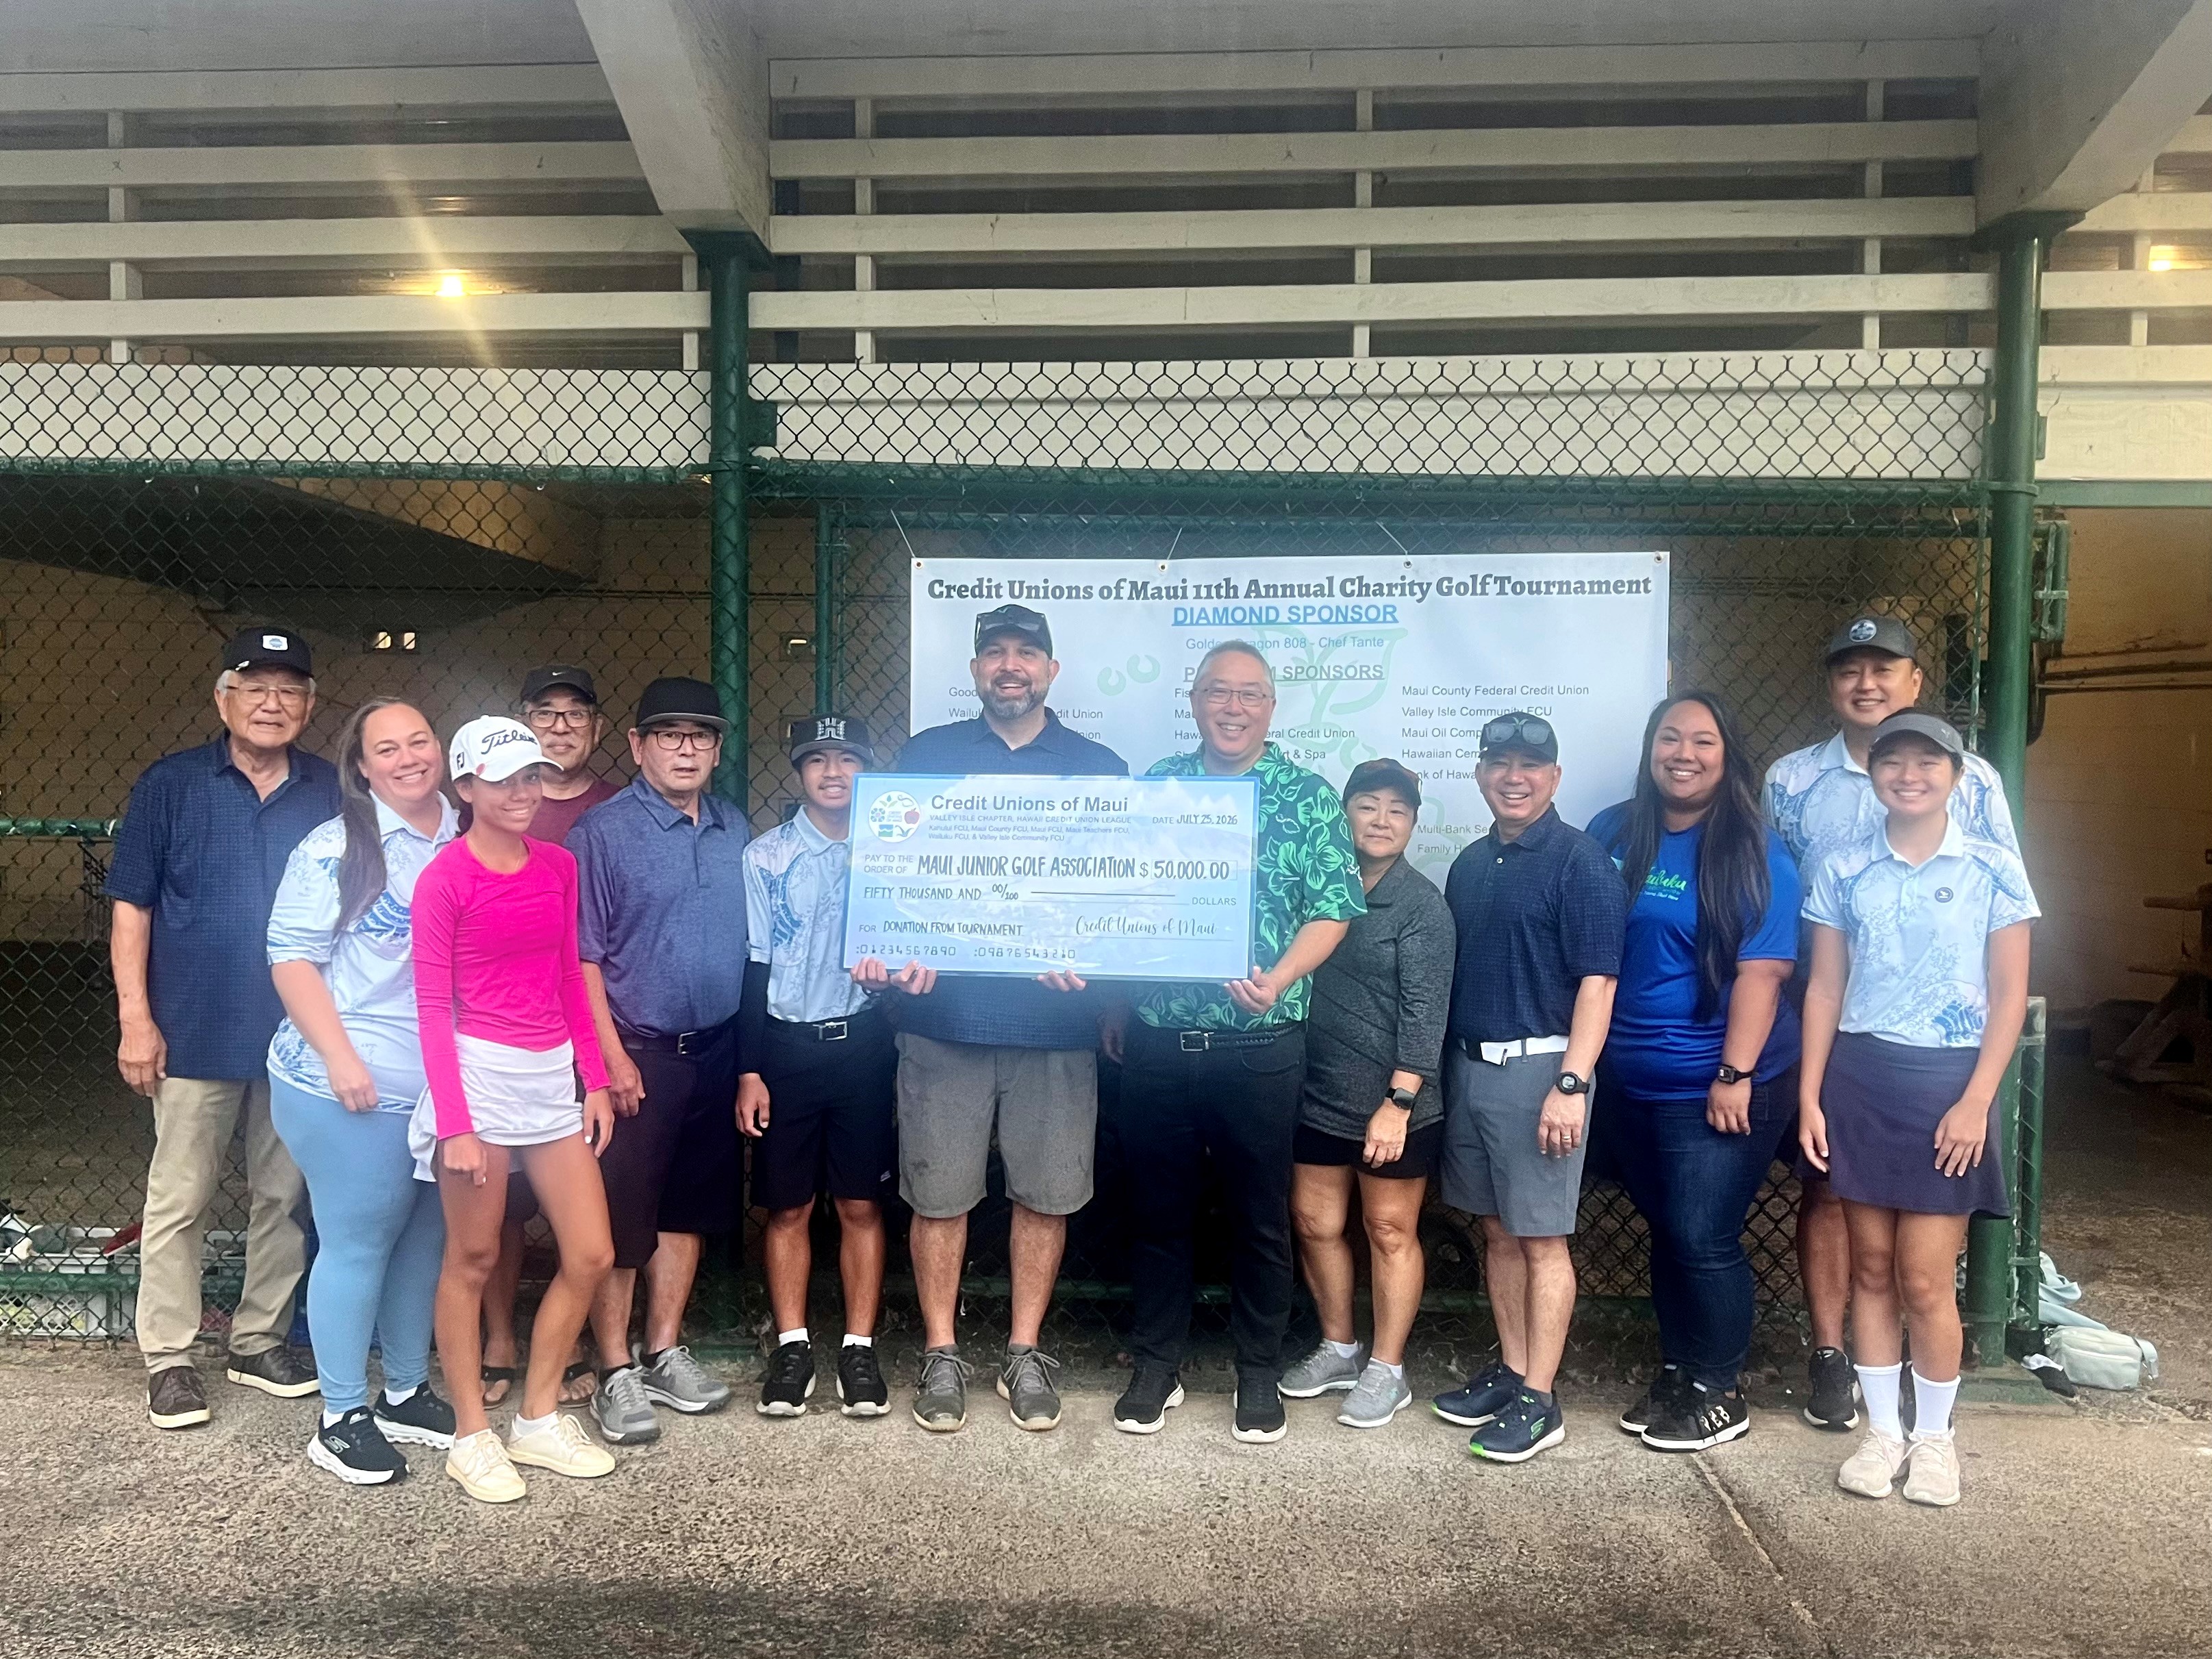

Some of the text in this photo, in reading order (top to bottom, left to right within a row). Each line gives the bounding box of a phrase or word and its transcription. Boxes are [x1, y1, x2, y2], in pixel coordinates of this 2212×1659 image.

[928, 574, 1652, 603] Credit Unions of Maui 11th Annual Charity Golf Tournament
[1173, 604, 1398, 625] DIAMOND SPONSOR
[1284, 636, 1307, 649] 808
[1318, 636, 1348, 649] Chef
[1350, 636, 1384, 648] Tante
[1282, 664, 1384, 680] SPONSORS
[1402, 685, 1589, 697] Maui County Federal Credit Union
[1072, 709, 1103, 719] Union
[1402, 706, 1434, 719] Valley
[1437, 706, 1457, 716] Isle
[1526, 706, 1553, 716] FCU
[1077, 729, 1101, 740] nion
[1287, 728, 1320, 739] Credit
[1323, 728, 1355, 738] Union
[1402, 727, 1482, 740] Maui Oil Comp
[1293, 749, 1301, 759] &
[1305, 749, 1326, 760] Spa
[1402, 749, 1481, 759] Hawaiian Cem
[1432, 769, 1444, 779] of
[1446, 769, 1476, 779] Hawa
[931, 795, 1129, 812] Credit Unions of Maui
[1153, 816, 1174, 824] DATE
[1177, 814, 1199, 825] JULY
[1216, 815, 1238, 825] 2026
[1418, 825, 1472, 834] Multi-Bank
[1418, 844, 1451, 855] Family
[864, 854, 882, 862] PAY
[897, 855, 914, 863] THE
[864, 865, 894, 873] ORDER
[918, 855, 1135, 878] MAUI JUNIOR GOLF ASSOCIATION
[1140, 862, 1149, 878] $
[864, 886, 895, 899] FIFTY
[898, 887, 953, 899] THOUSAND
[958, 888, 982, 901] AND
[1192, 897, 1237, 906] DOLLARS
[883, 921, 1024, 936] DONATION FROM TOURNAMENT
[1075, 914, 1218, 936] Credit Unions of Maui
